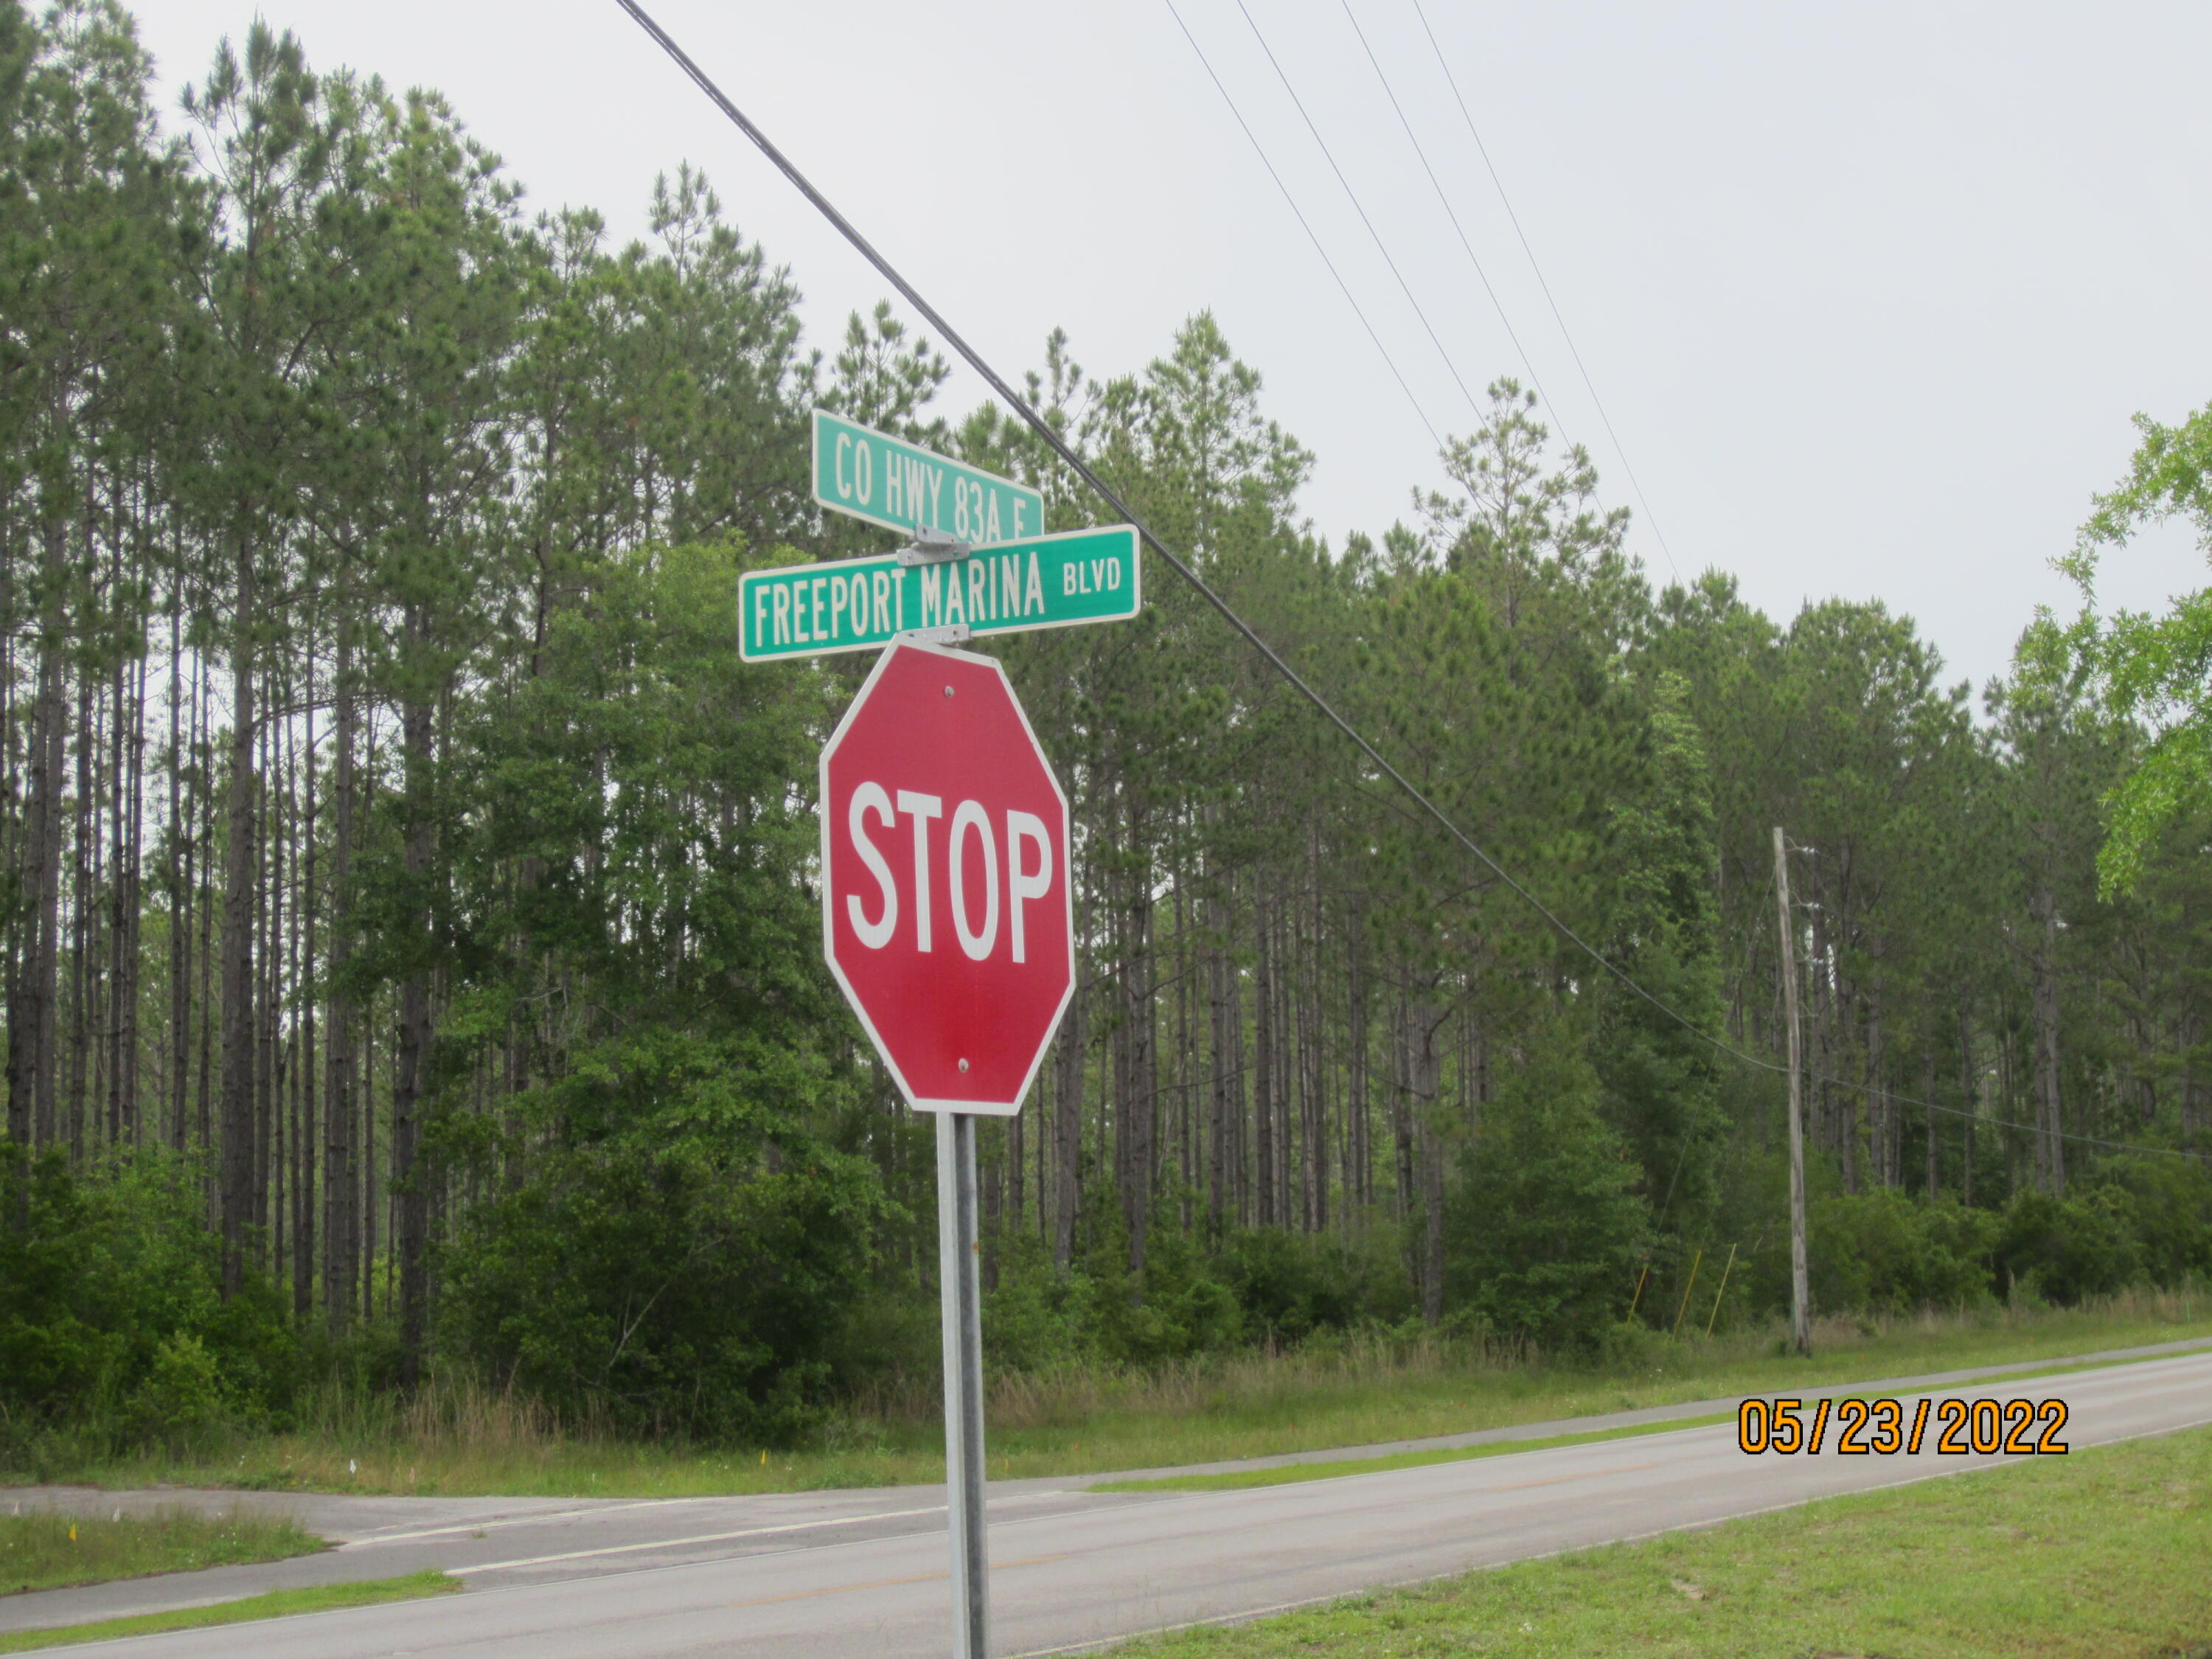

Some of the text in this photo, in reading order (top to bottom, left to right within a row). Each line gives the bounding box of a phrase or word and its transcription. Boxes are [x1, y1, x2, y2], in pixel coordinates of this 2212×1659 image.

[836, 432, 872, 505] CO
[886, 450, 943, 529] HWY
[955, 476, 1001, 543] 83A
[755, 552, 1121, 647] FREEPORT MARINA BLVD
[846, 781, 1053, 964] STOP
